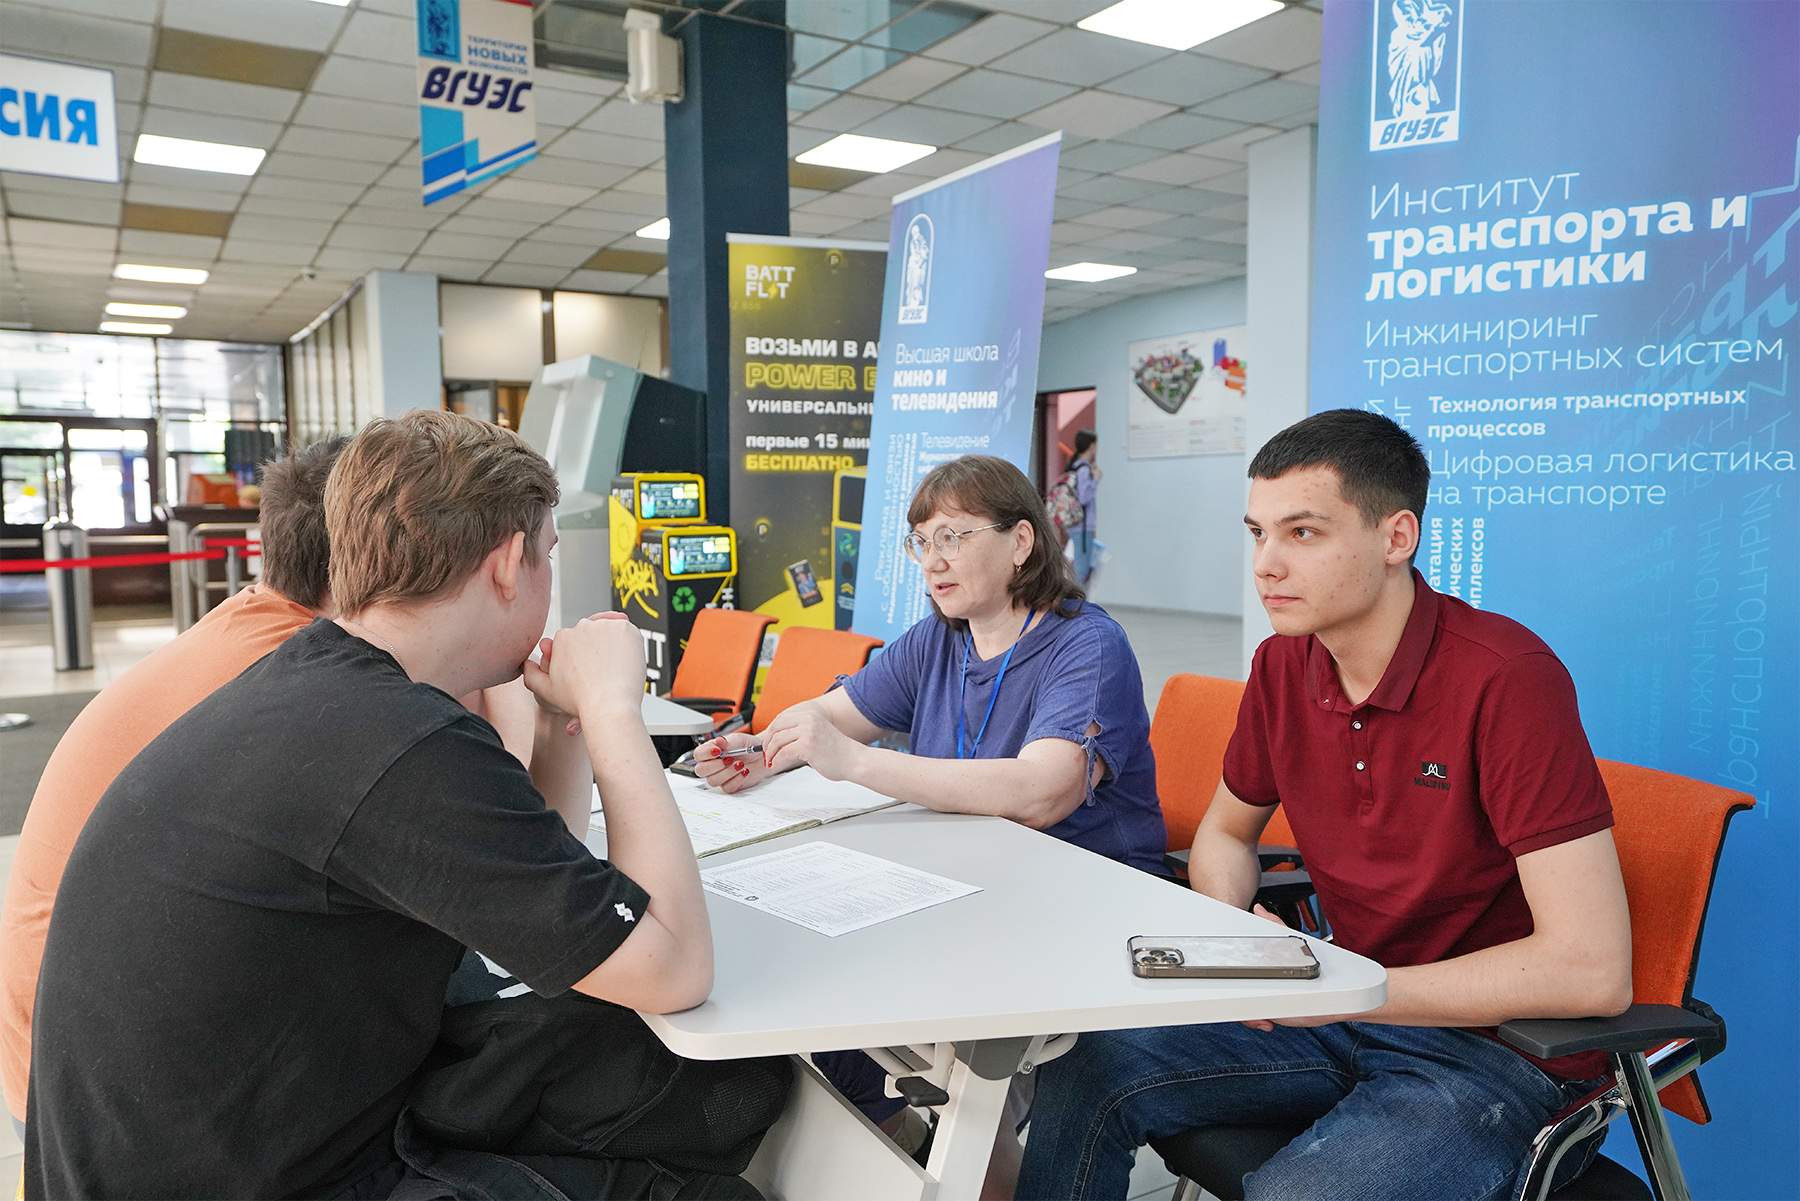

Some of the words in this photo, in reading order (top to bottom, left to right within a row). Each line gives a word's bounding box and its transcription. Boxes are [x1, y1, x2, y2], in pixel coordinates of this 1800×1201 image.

[467, 45, 527, 65] НОВЫХ
[421, 66, 533, 113] ВГУЭС
[1379, 116, 1449, 145] ВГУЭС
[1371, 172, 1580, 220] Институт
[1367, 201, 1694, 270] транспорта
[1711, 195, 1748, 229] и
[745, 264, 796, 282] BATT
[1365, 250, 1647, 301] логистики
[1365, 314, 1599, 349] Инжиниринг
[745, 337, 838, 358] ВОЗЬМИ
[843, 340, 859, 358] В
[896, 343, 950, 364] Высшая
[954, 344, 999, 363] школа
[1363, 347, 1623, 387] транспортных
[1637, 338, 1783, 368] систем
[745, 362, 857, 392] POWER
[893, 369, 933, 388] кино
[936, 369, 947, 387] и
[891, 391, 999, 413] телевидения
[1428, 395, 1557, 414] Технология
[1563, 390, 1746, 414] транспортных
[745, 434, 810, 451] первые
[815, 433, 839, 448] 15
[920, 431, 991, 450] Телевидение
[1427, 421, 1547, 442] процессов
[745, 454, 856, 472] БЕСПЛАТНО
[1428, 449, 1593, 480] Цифровая
[1604, 450, 1797, 473] логистика
[1428, 486, 1462, 505] на
[1472, 484, 1667, 511] транспорте
